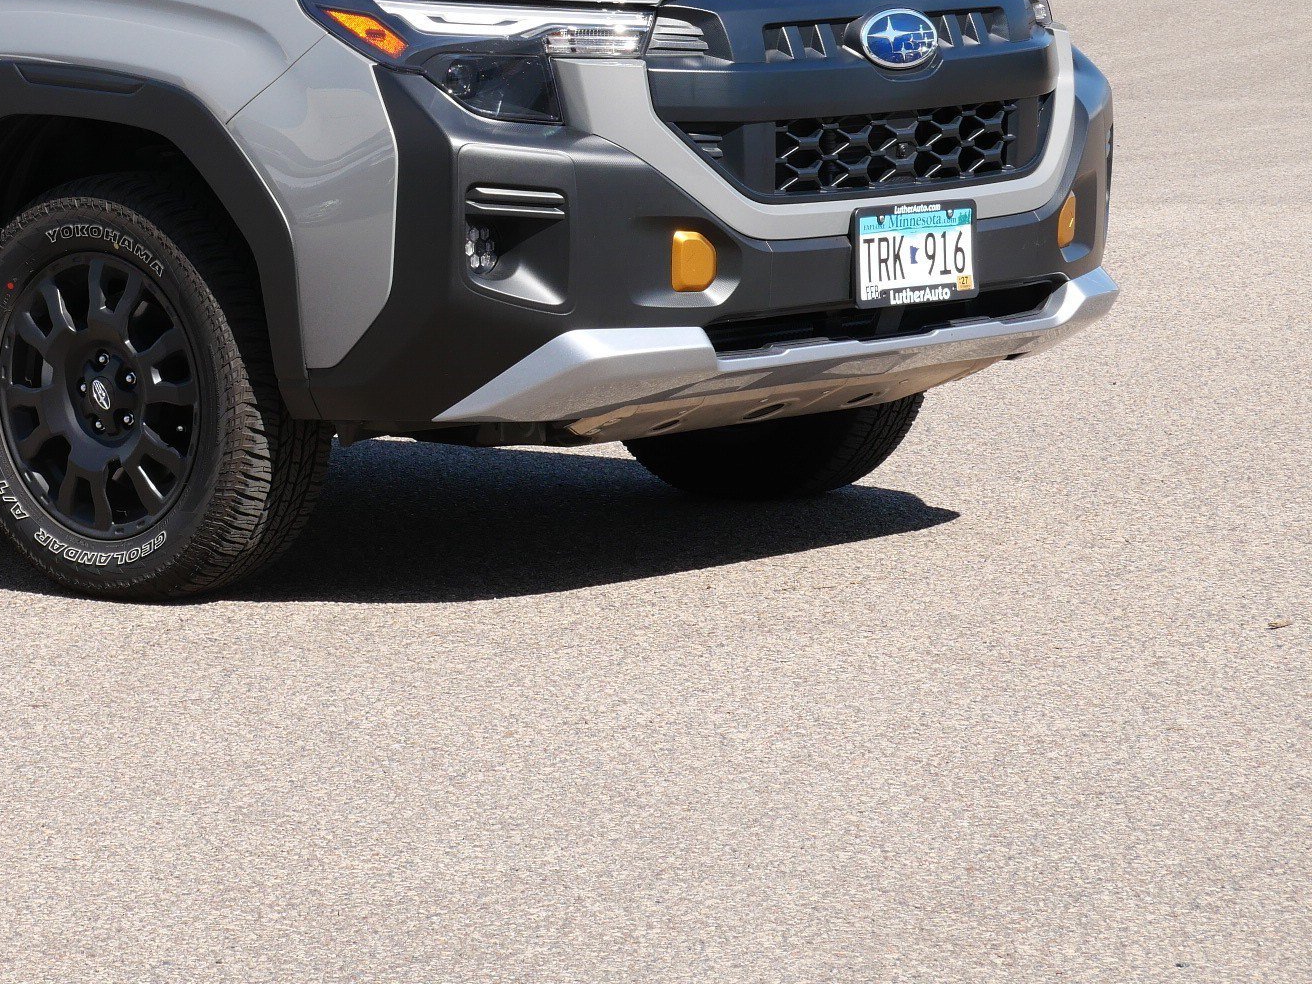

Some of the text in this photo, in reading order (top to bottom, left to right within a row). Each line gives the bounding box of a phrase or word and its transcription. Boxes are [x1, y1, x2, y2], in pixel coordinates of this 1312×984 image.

[894, 203, 942, 215] LutherAuto.com
[45, 223, 165, 278] YOKOHAMA
[862, 230, 966, 283] TRK 916
[889, 286, 951, 305] LutherAuto
[34, 530, 168, 567] GEOLANDAR
